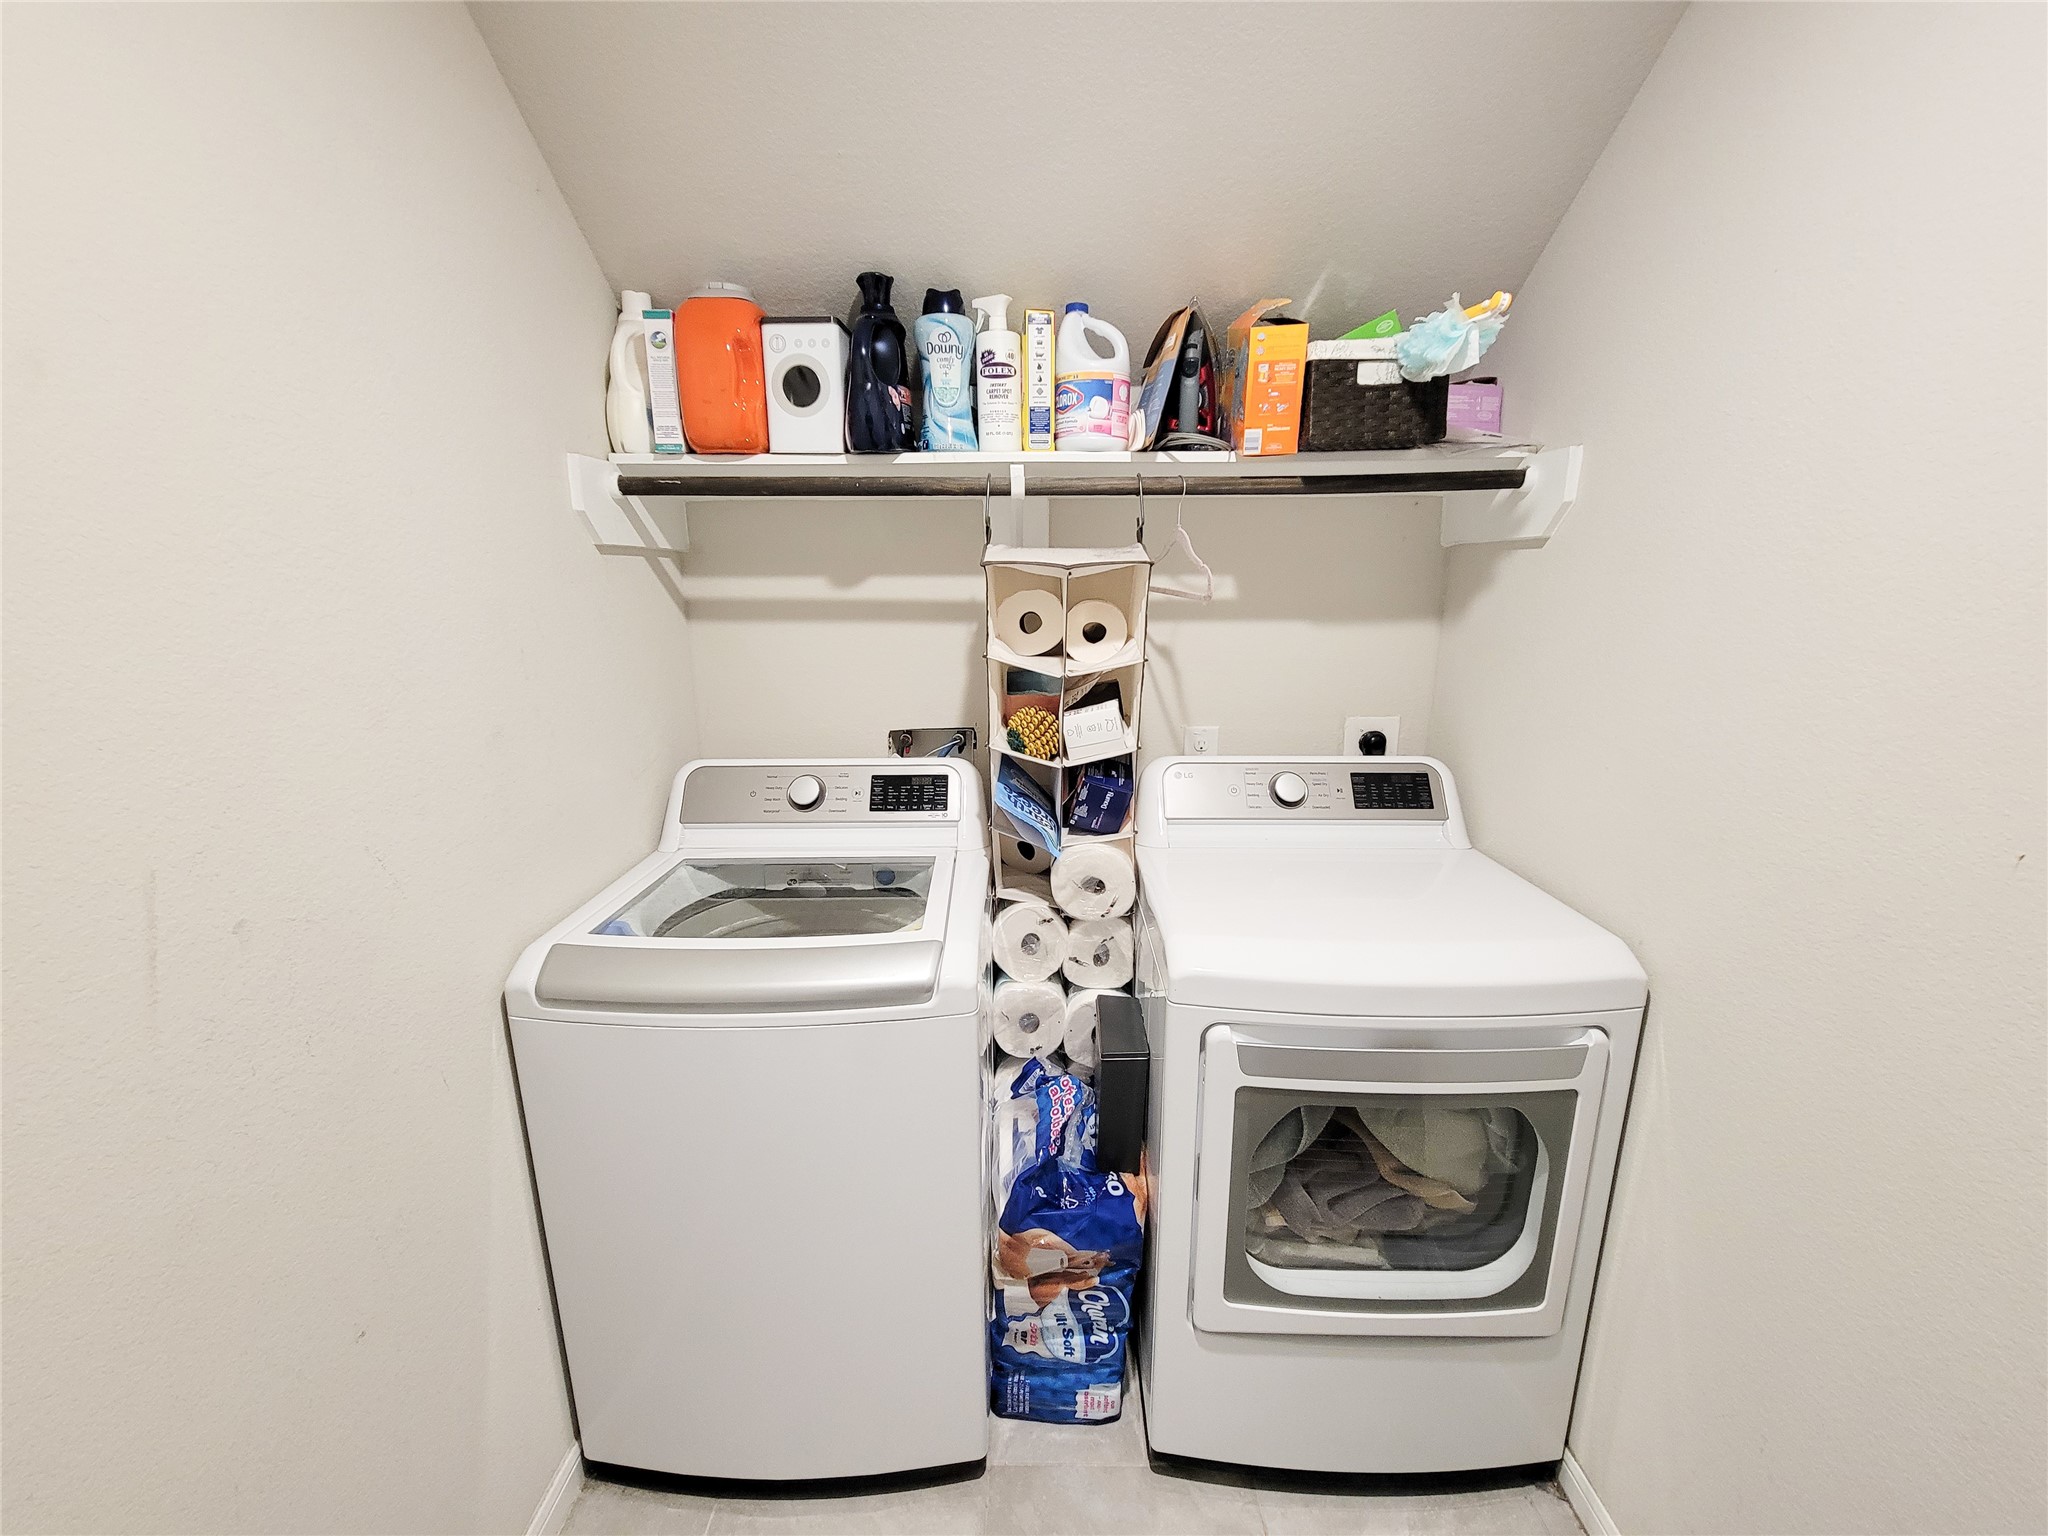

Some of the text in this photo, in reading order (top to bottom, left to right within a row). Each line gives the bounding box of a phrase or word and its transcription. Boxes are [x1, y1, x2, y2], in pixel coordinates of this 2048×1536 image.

[926, 342, 964, 359] Downy
[983, 367, 1013, 375] FOLEX
[1055, 393, 1078, 408] LOROX
[1062, 1328, 1076, 1358] Soft
